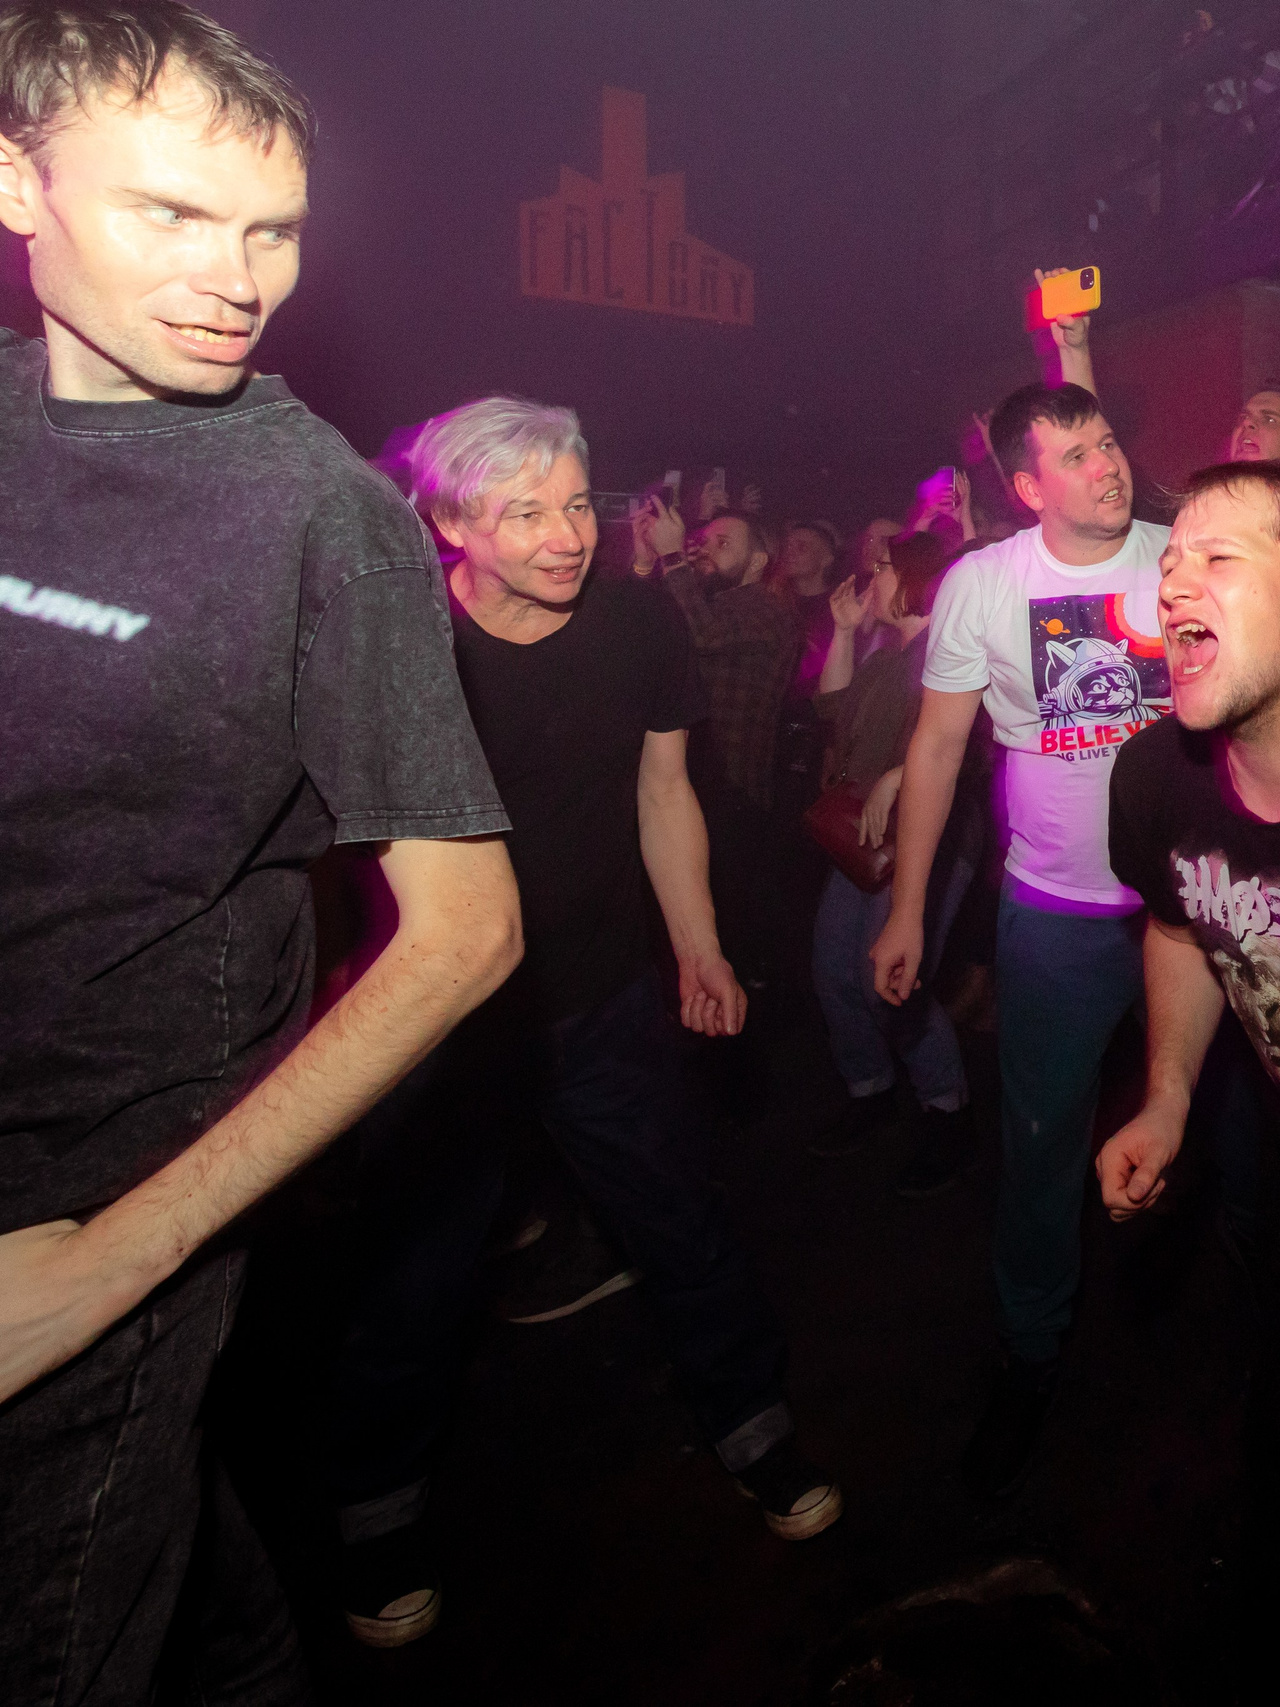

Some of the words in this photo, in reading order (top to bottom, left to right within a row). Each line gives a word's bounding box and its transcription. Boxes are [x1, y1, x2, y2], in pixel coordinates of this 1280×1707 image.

[528, 187, 749, 317] FACTORY
[1040, 719, 1158, 754] BELIEV
[1079, 746, 1110, 761] LIVE
